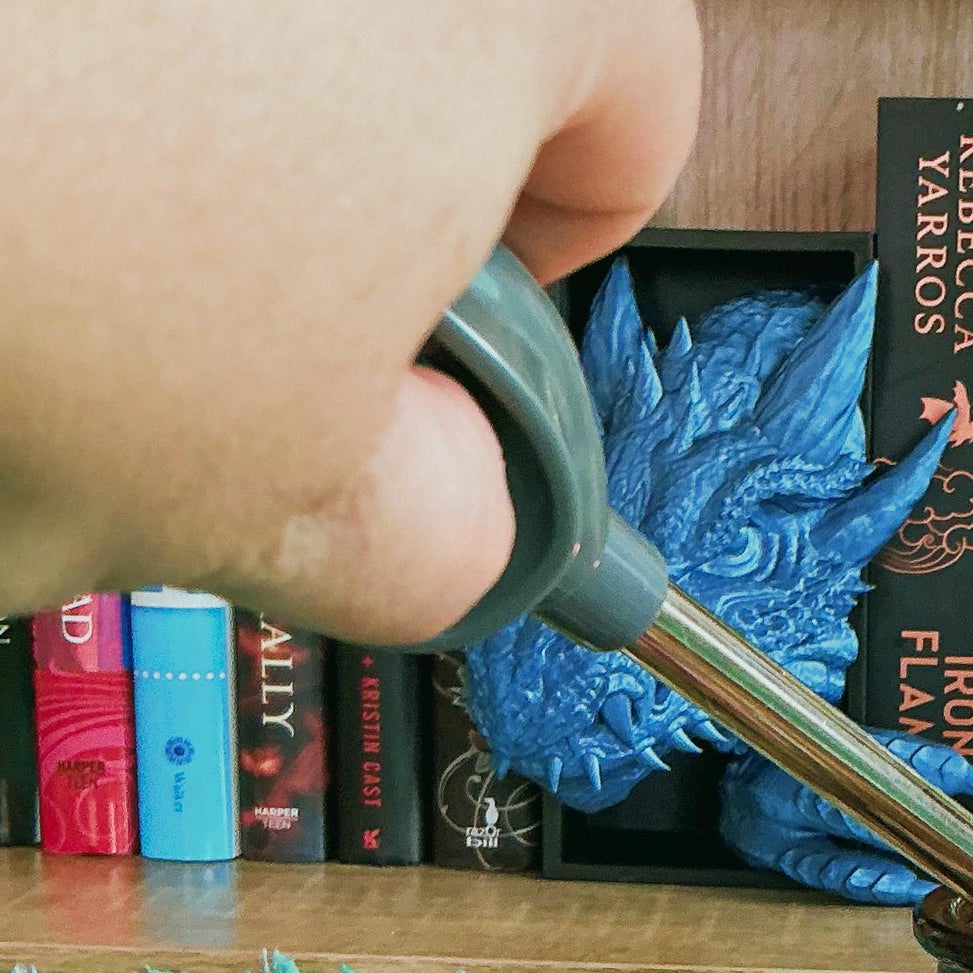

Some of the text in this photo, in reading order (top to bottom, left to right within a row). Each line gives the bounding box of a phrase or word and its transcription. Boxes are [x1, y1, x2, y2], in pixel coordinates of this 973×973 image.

[914, 151, 950, 334] YARROS
[360, 677, 382, 808] KRISTIN CAST
[254, 807, 299, 820] HARPER
